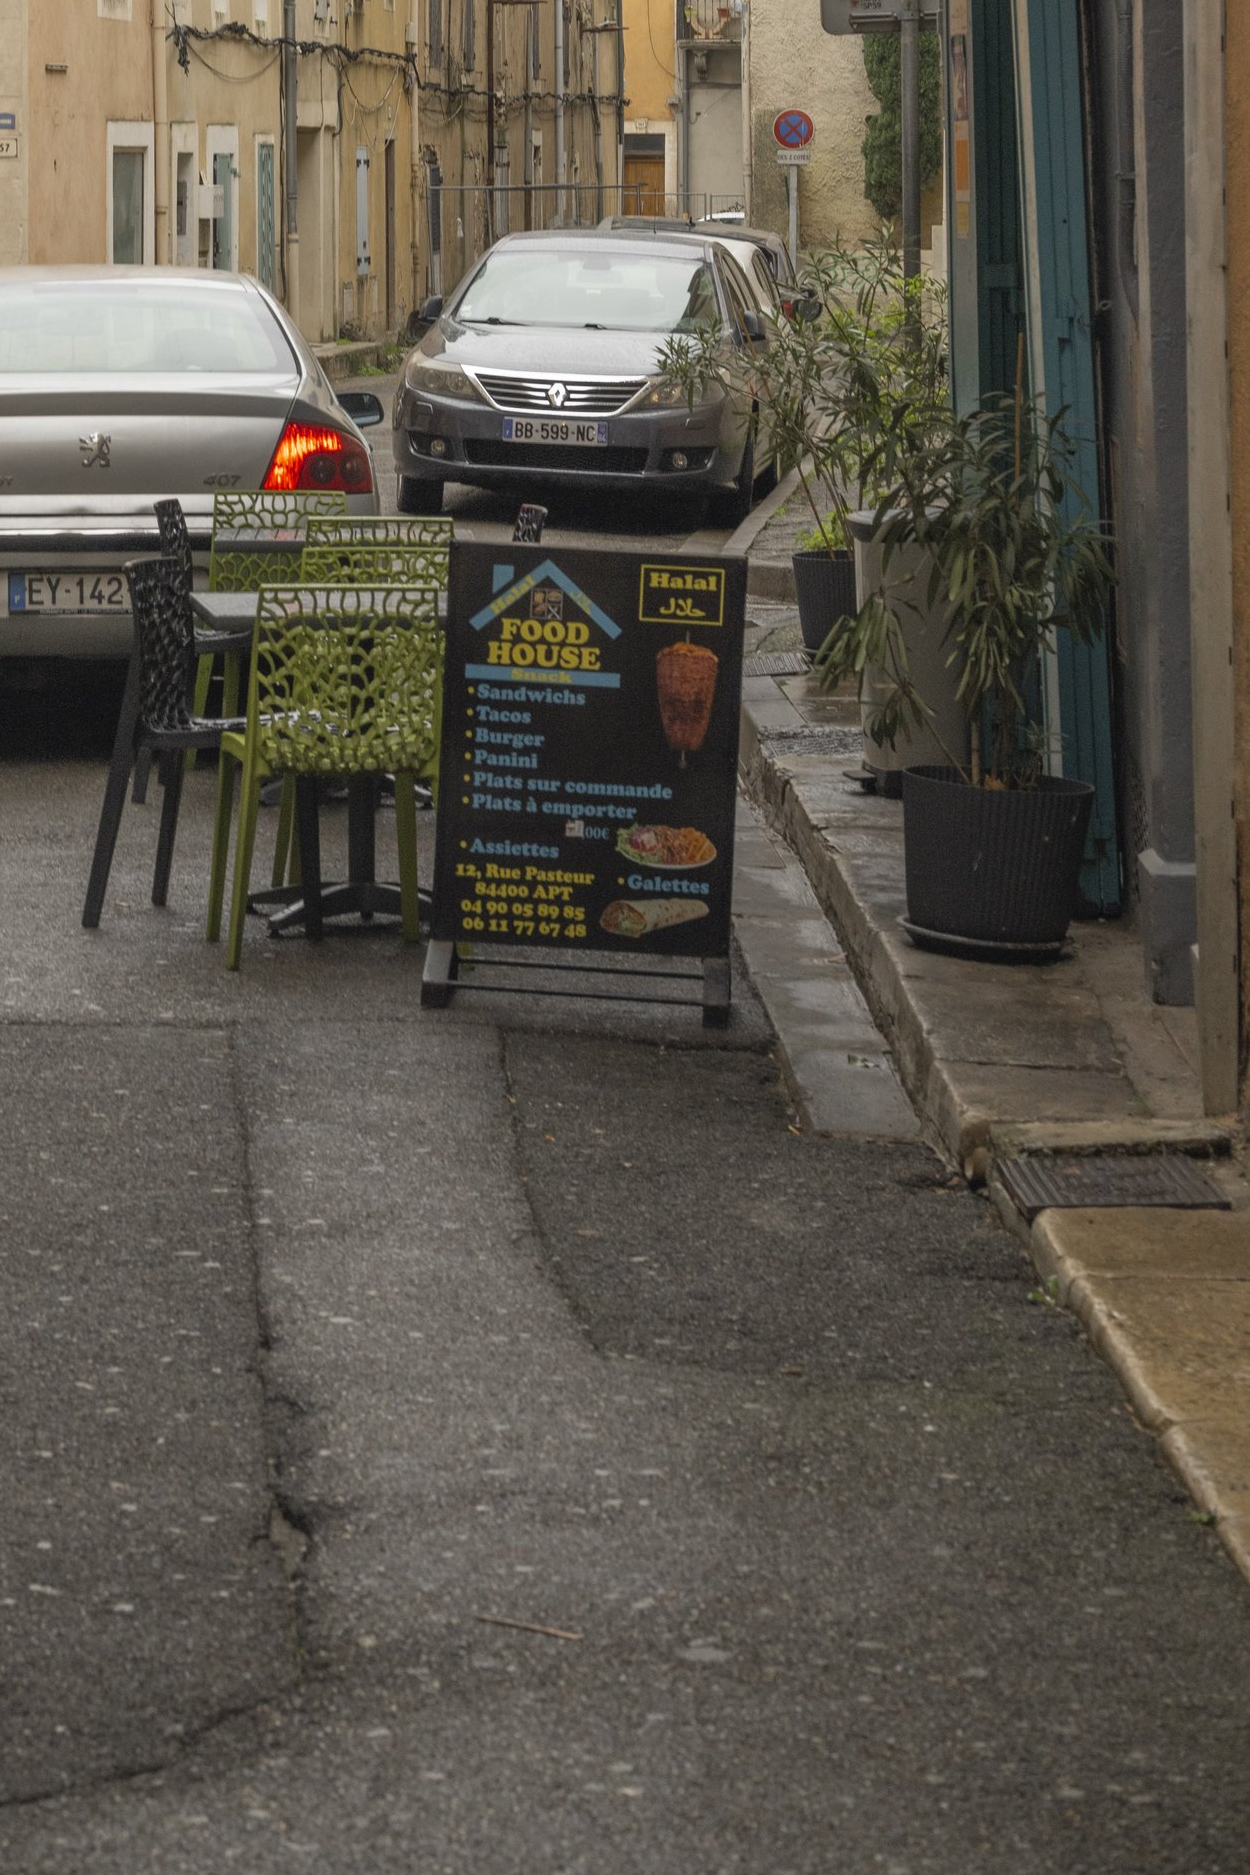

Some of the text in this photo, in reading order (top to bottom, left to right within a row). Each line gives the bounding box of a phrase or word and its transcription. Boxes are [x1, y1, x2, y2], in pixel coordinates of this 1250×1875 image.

[0, 143, 10, 153] 57
[514, 421, 596, 443] BB-599-NC
[203, 474, 242, 487] 407
[650, 572, 717, 591] Halal
[491, 575, 536, 615] Halal
[660, 597, 706, 617] حلال
[501, 618, 590, 644] FOOD
[487, 641, 601, 670] HOUSE
[511, 668, 572, 683] Snack
[477, 683, 586, 705] Sandwichs
[476, 705, 532, 724] Tacos
[475, 727, 545, 749] Burger
[474, 749, 538, 769] Panini
[473, 771, 673, 799] Plats sur commande
[472, 793, 637, 819] Plats à emporter
[584, 827, 610, 840] 00€
[470, 837, 560, 859] Assiettes
[455, 863, 596, 885] 12, Rue Pasteur
[627, 874, 710, 895] Galettes
[474, 882, 573, 901] 84400 APT
[460, 900, 586, 921] 04 90 05 89 85
[462, 917, 588, 939] 06 11 77 67 48
